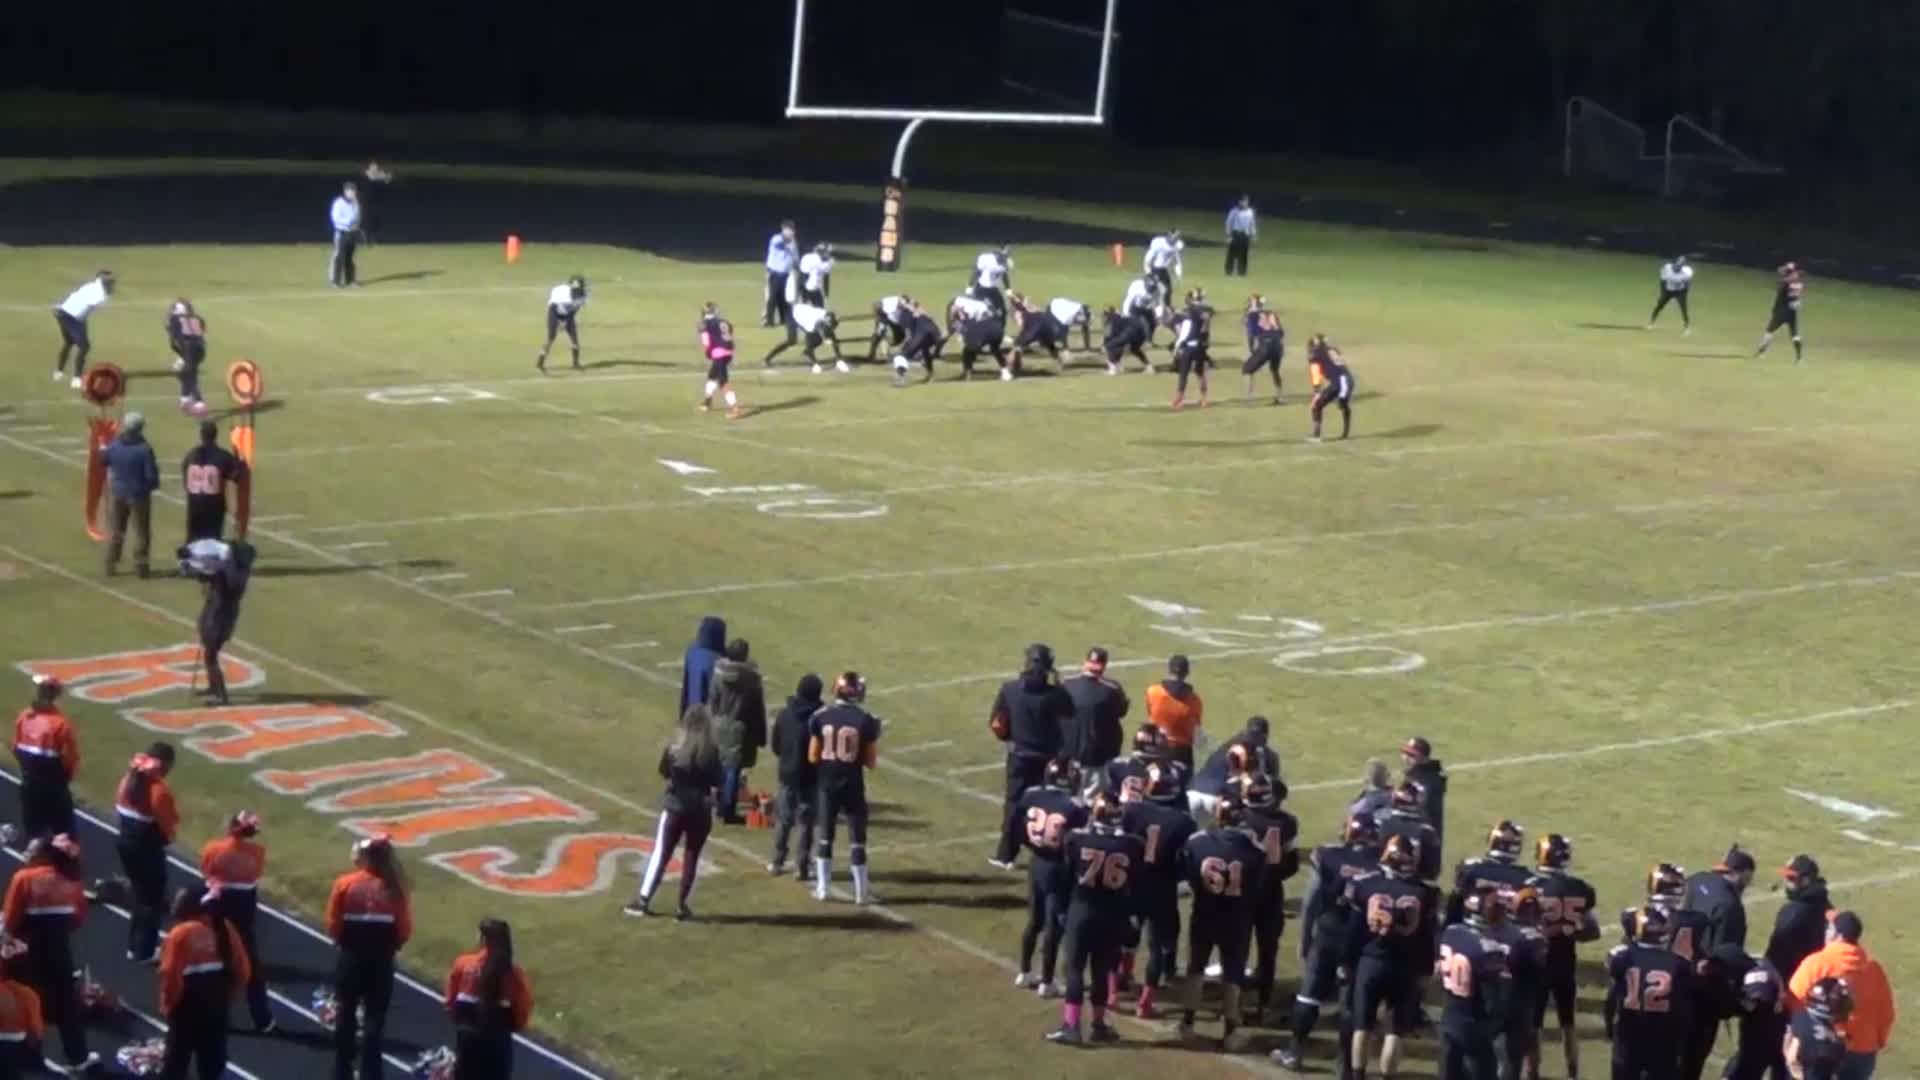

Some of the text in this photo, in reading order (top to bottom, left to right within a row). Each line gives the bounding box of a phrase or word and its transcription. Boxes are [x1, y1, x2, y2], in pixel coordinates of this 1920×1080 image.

[821, 724, 860, 762] 10
[16, 642, 718, 898] RAMS
[1078, 847, 1131, 889] 76
[1201, 856, 1242, 896] 61
[1623, 967, 1672, 1013] 12
